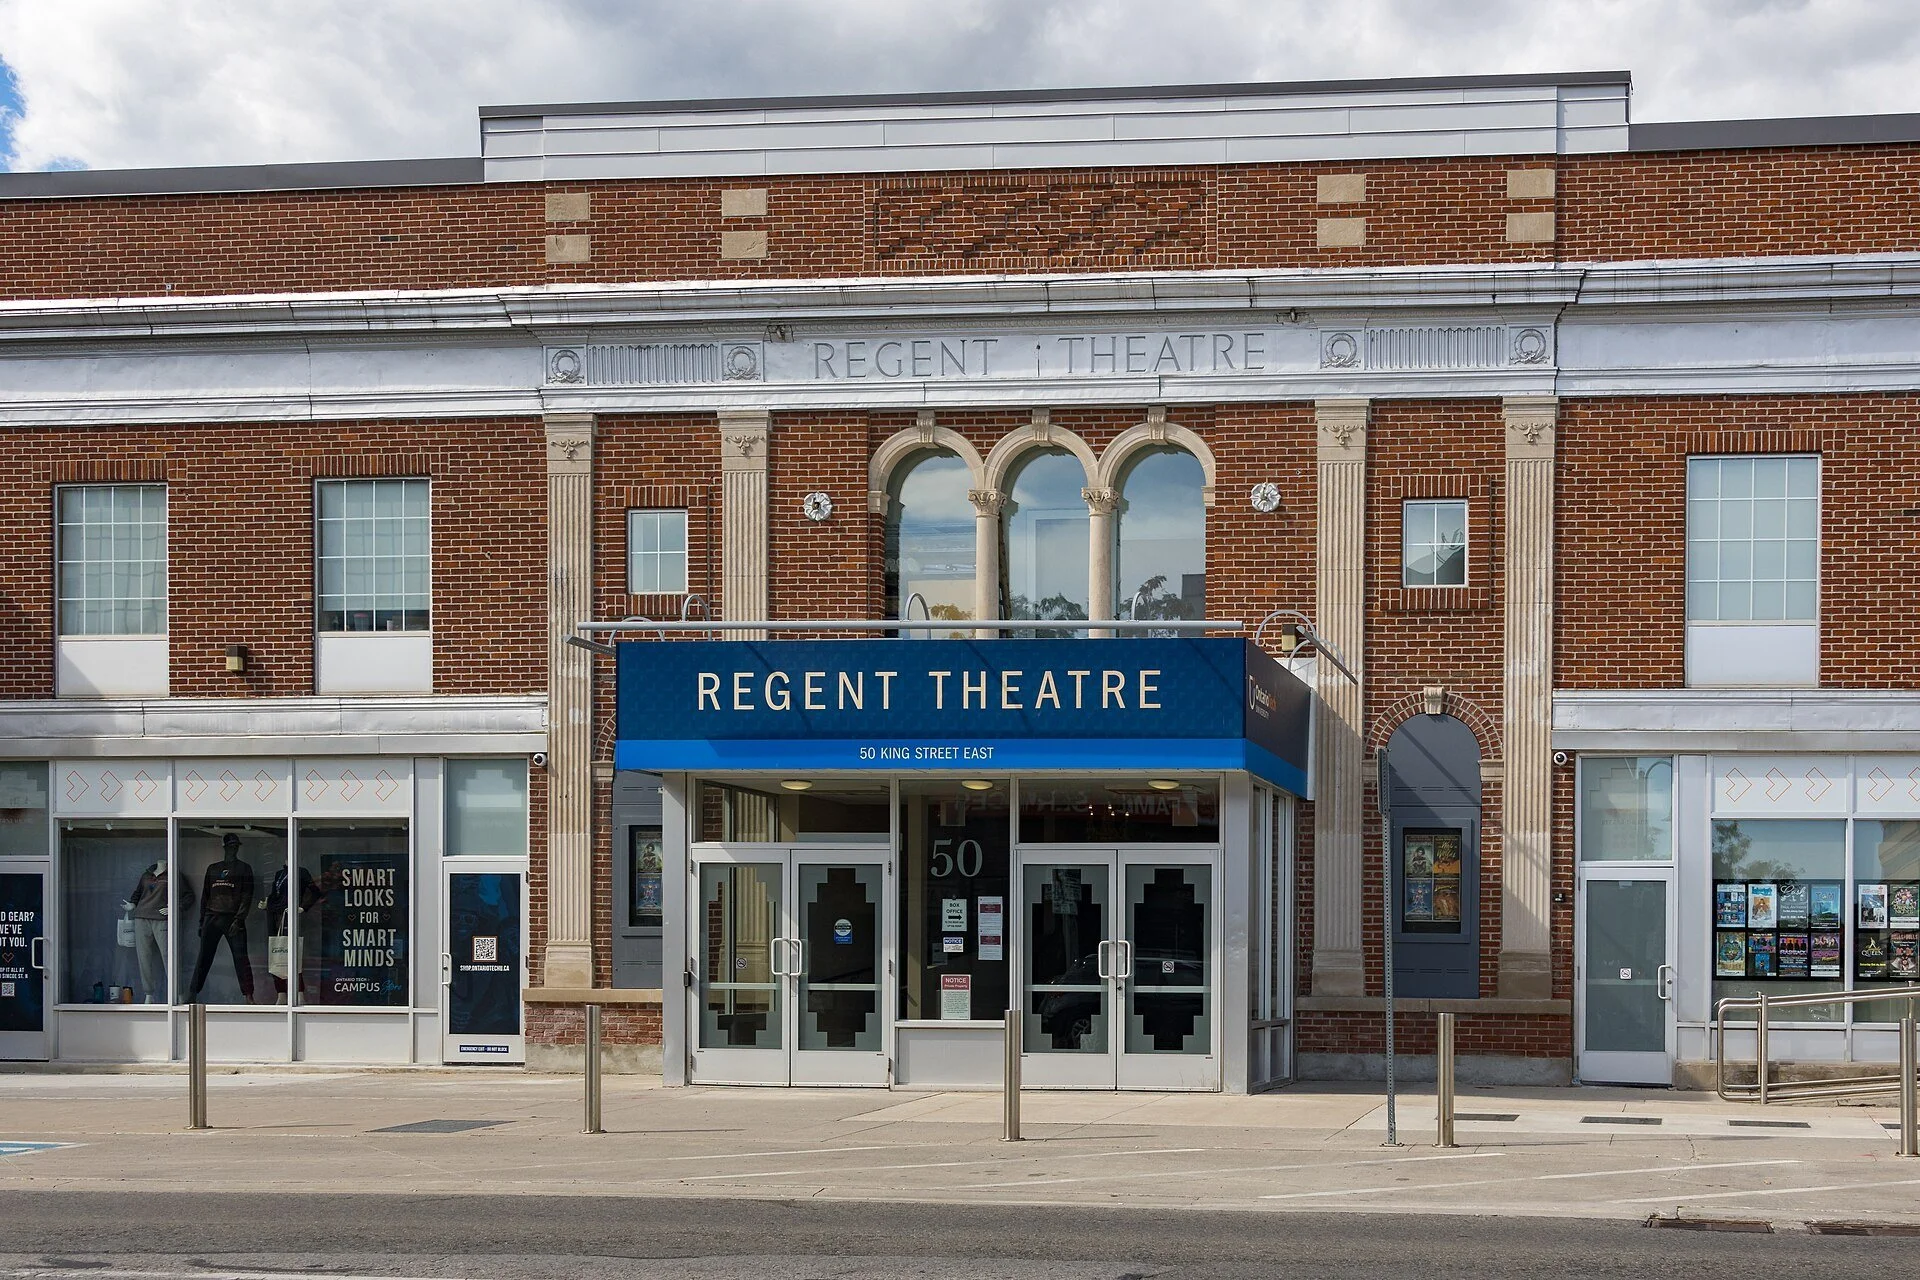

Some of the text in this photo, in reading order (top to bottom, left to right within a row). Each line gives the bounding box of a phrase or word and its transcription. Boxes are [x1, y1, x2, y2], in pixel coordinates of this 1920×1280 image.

[813, 332, 1266, 380] REGENT THEATRE
[697, 670, 1163, 711] REGENT THEATRE
[859, 745, 994, 760] 50 KING STREET EAST
[930, 839, 983, 877] 50
[342, 868, 396, 887] SMART
[344, 889, 395, 907] LOOKS
[8, 911, 35, 922] GEAR?
[359, 911, 379, 924] FOR
[0, 937, 28, 948] T YOU.
[342, 929, 397, 947] SMART
[344, 949, 395, 967] MINDS
[459, 964, 510, 972] SHOP.ONTARIOTECHU.CA
[334, 982, 380, 992] CAMPUS
